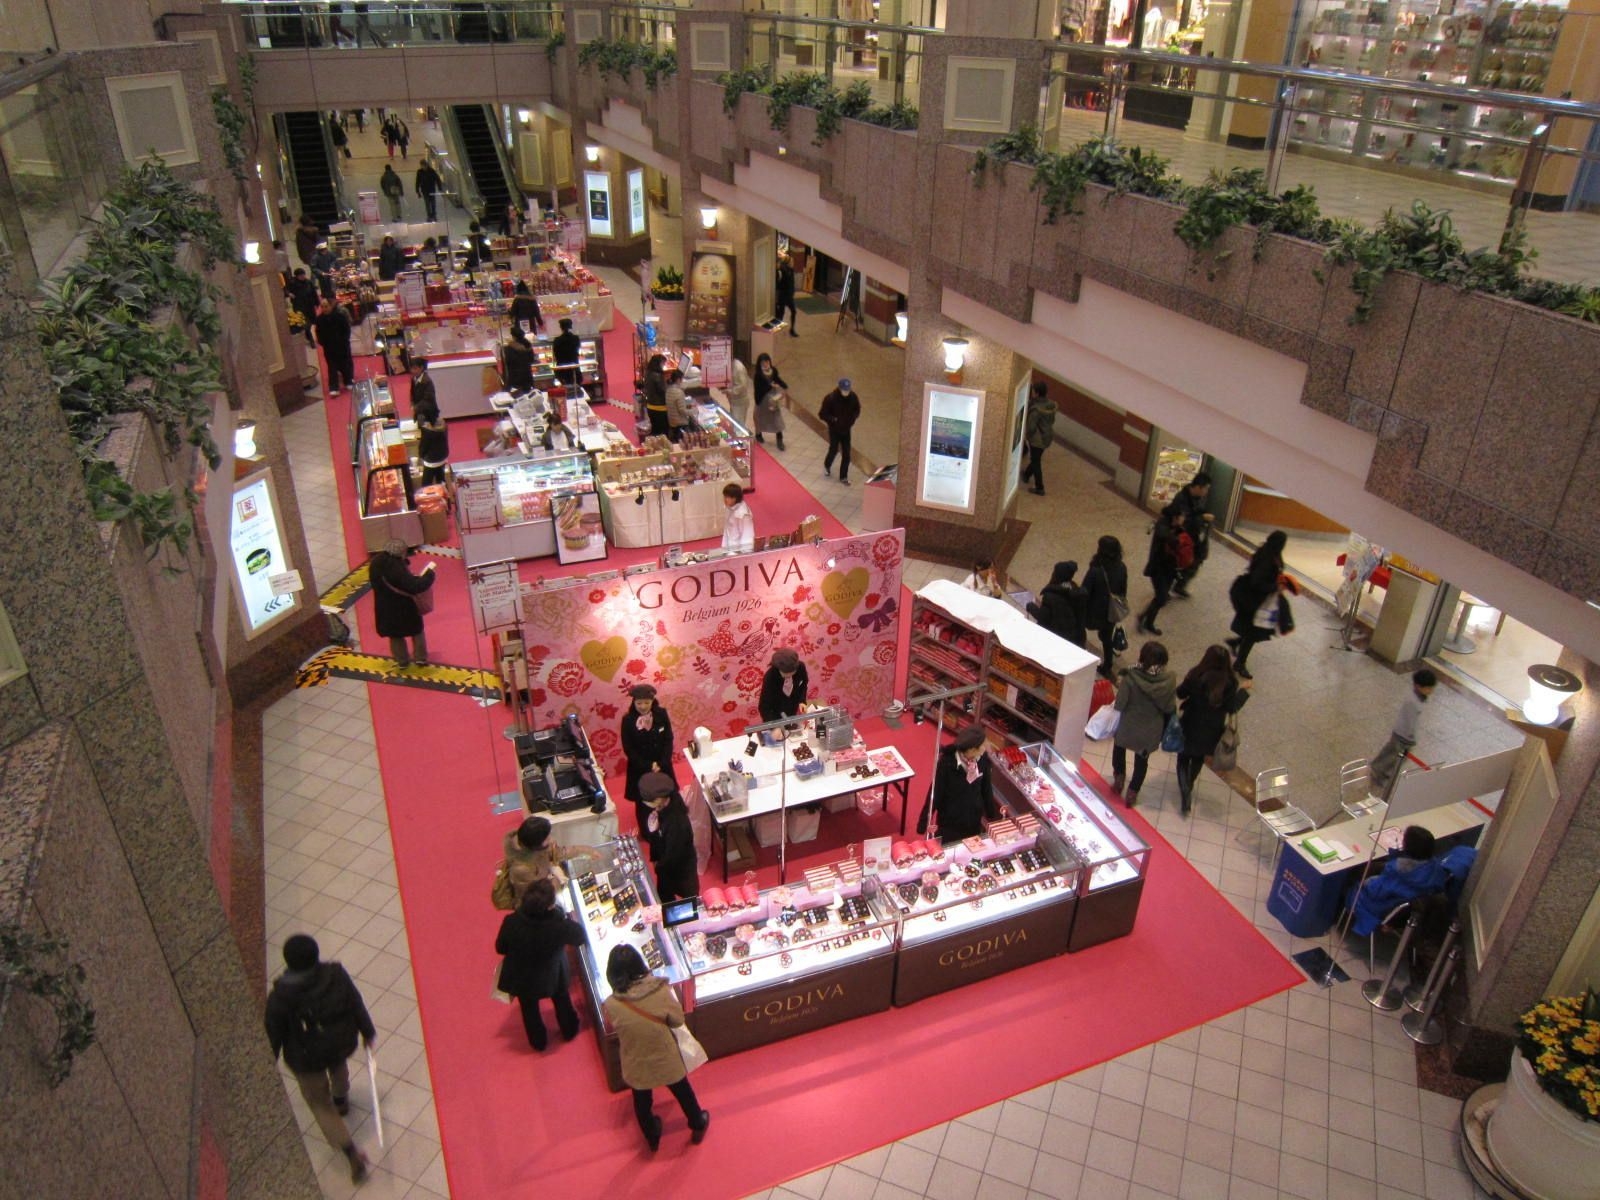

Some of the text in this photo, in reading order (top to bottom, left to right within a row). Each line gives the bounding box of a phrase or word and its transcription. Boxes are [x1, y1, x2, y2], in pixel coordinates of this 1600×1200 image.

[637, 557, 804, 609] GODIVA
[682, 598, 762, 622] Belgium 1926
[939, 929, 1027, 966] GODIVA
[743, 983, 844, 1021] GODIVA
